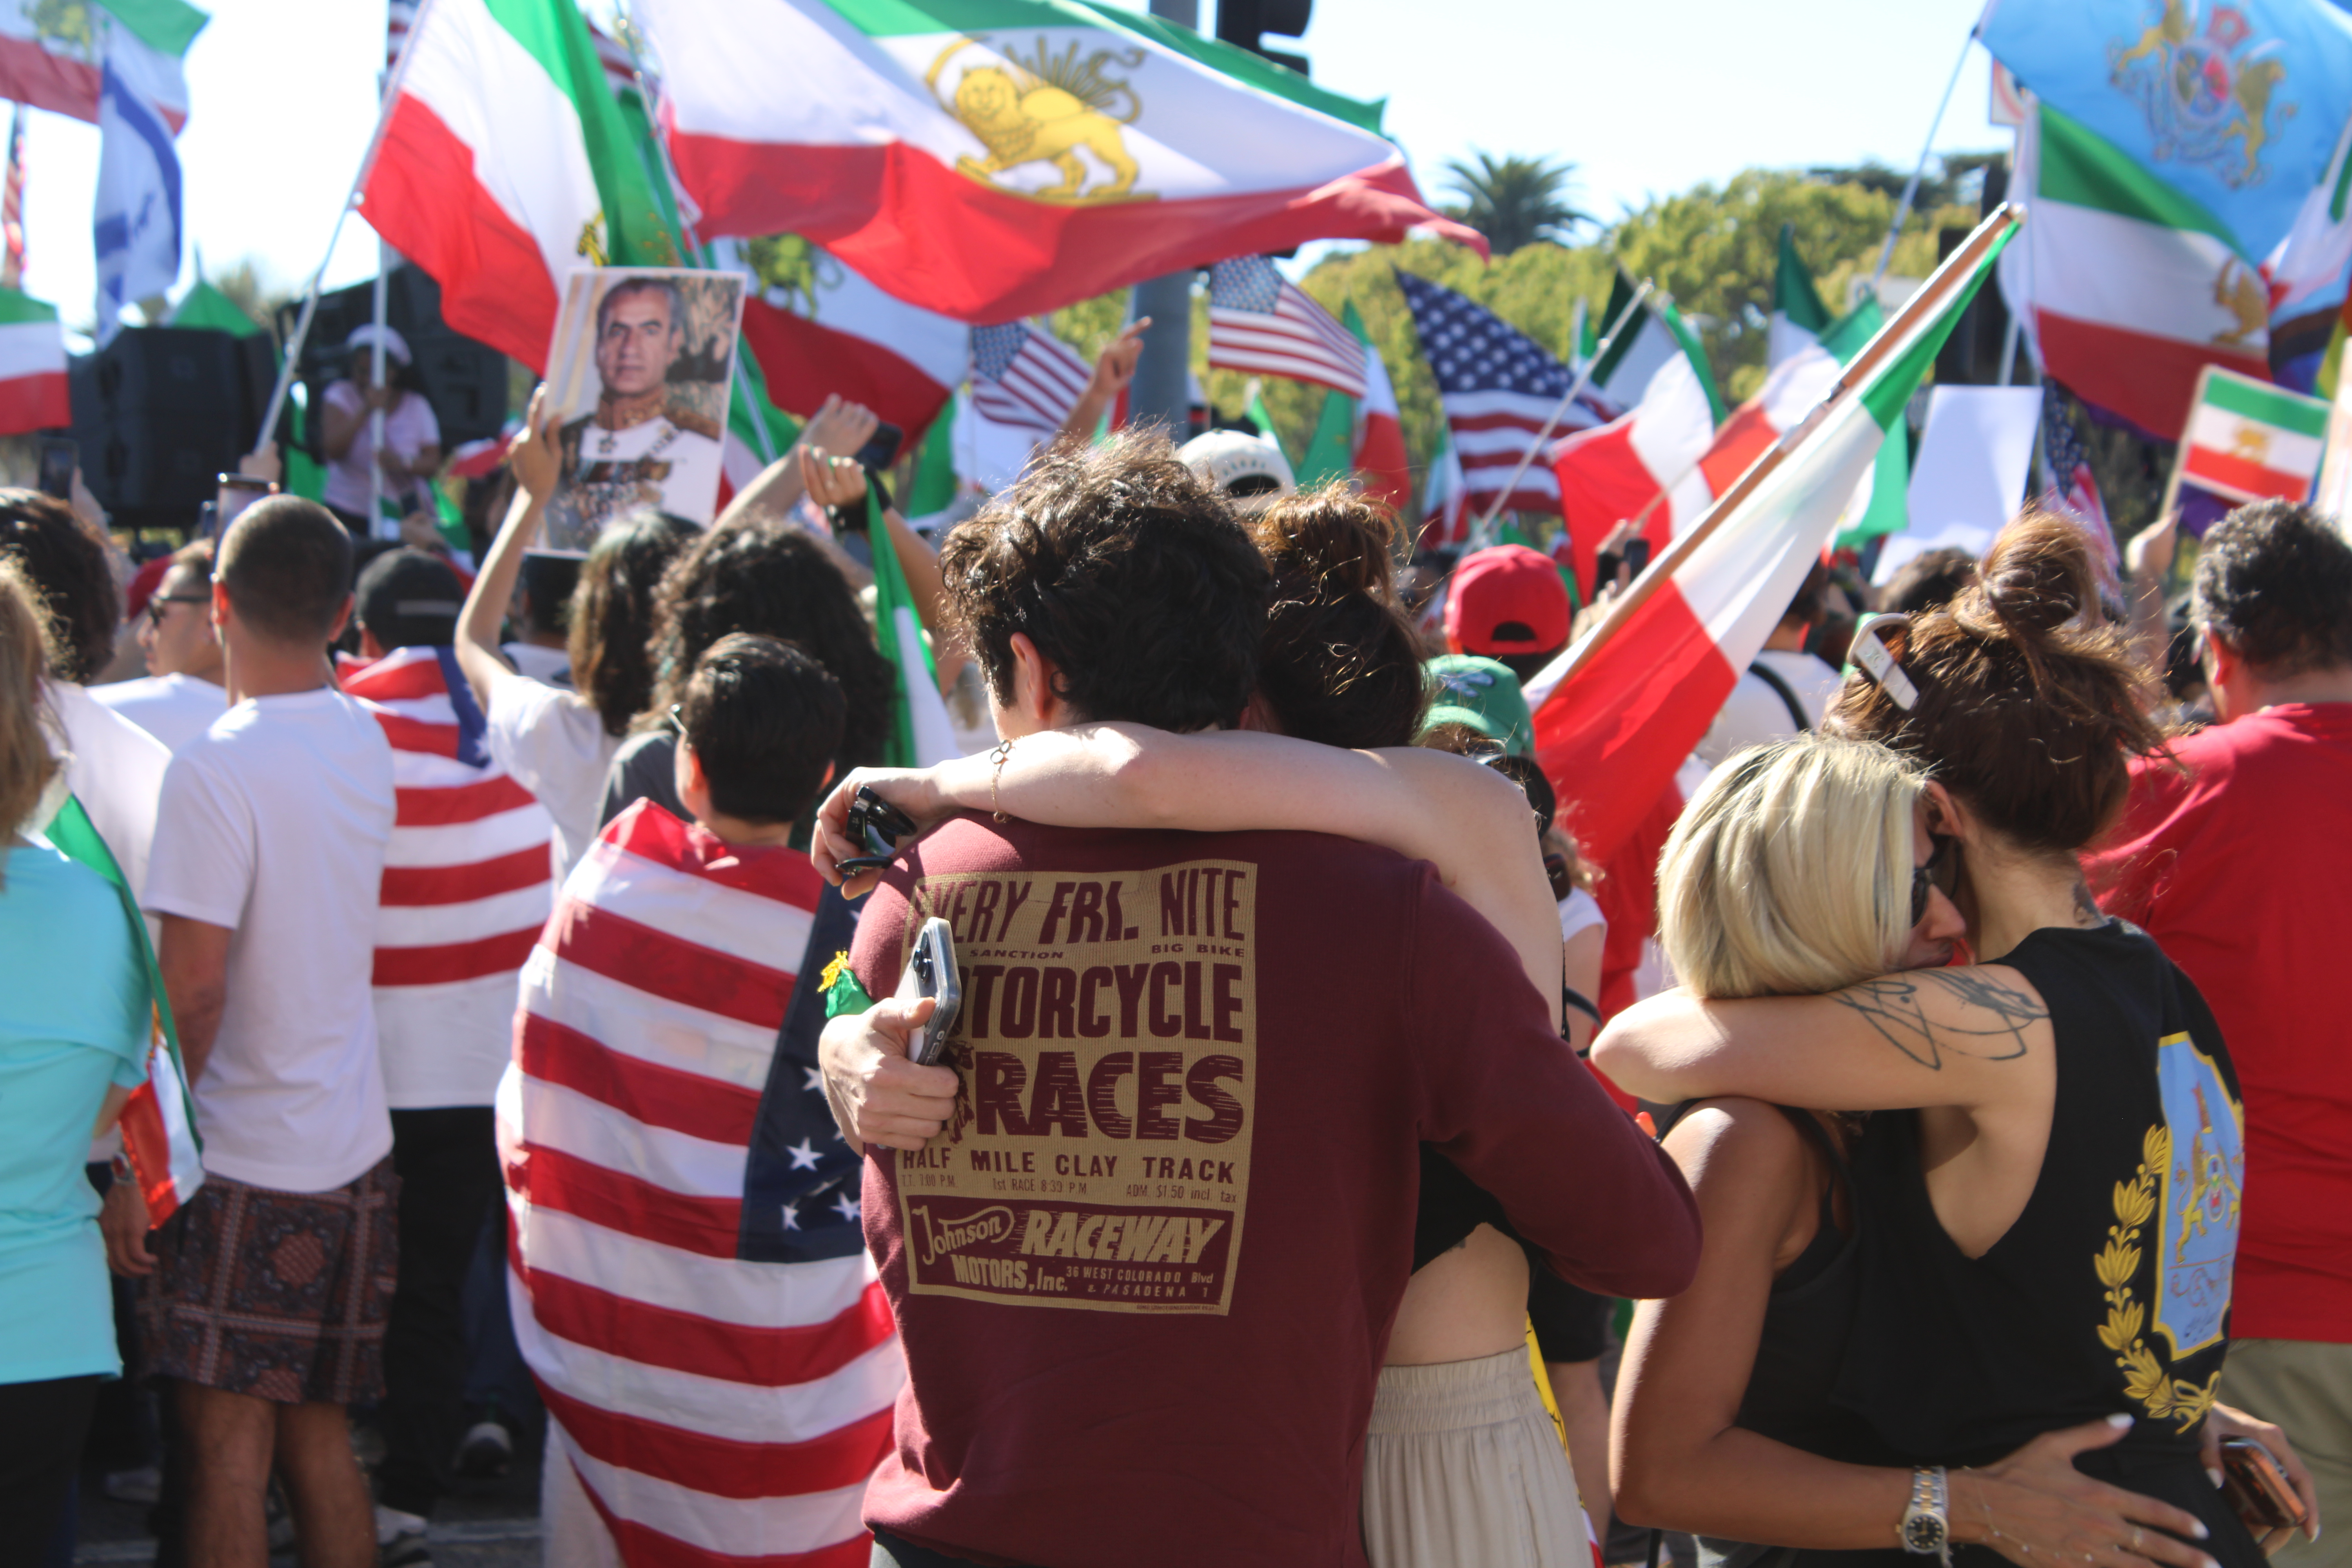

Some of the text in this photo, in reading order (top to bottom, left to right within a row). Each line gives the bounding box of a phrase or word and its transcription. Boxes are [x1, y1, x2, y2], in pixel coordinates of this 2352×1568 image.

[1038, 881, 1139, 944] FRI.
[1161, 867, 1246, 941] NITE
[970, 943, 1245, 959] SANCTION BIG BIKE
[949, 962, 1243, 1043] TORCYCLE
[976, 1051, 1244, 1144] RACES
[903, 1147, 1235, 1184] HALF MILE CLAY TRACK
[993, 1178, 1007, 1191] 1st
[1012, 1179, 1036, 1192] RACE
[1220, 1190, 1236, 1203] tax
[912, 1205, 1225, 1265] Johnson RACEWAY
[1037, 1267, 1068, 1291] Inc.
[1066, 1266, 1214, 1283] 36 WEST COLORADO Blvd
[1103, 1283, 1186, 1297] PASADENA
